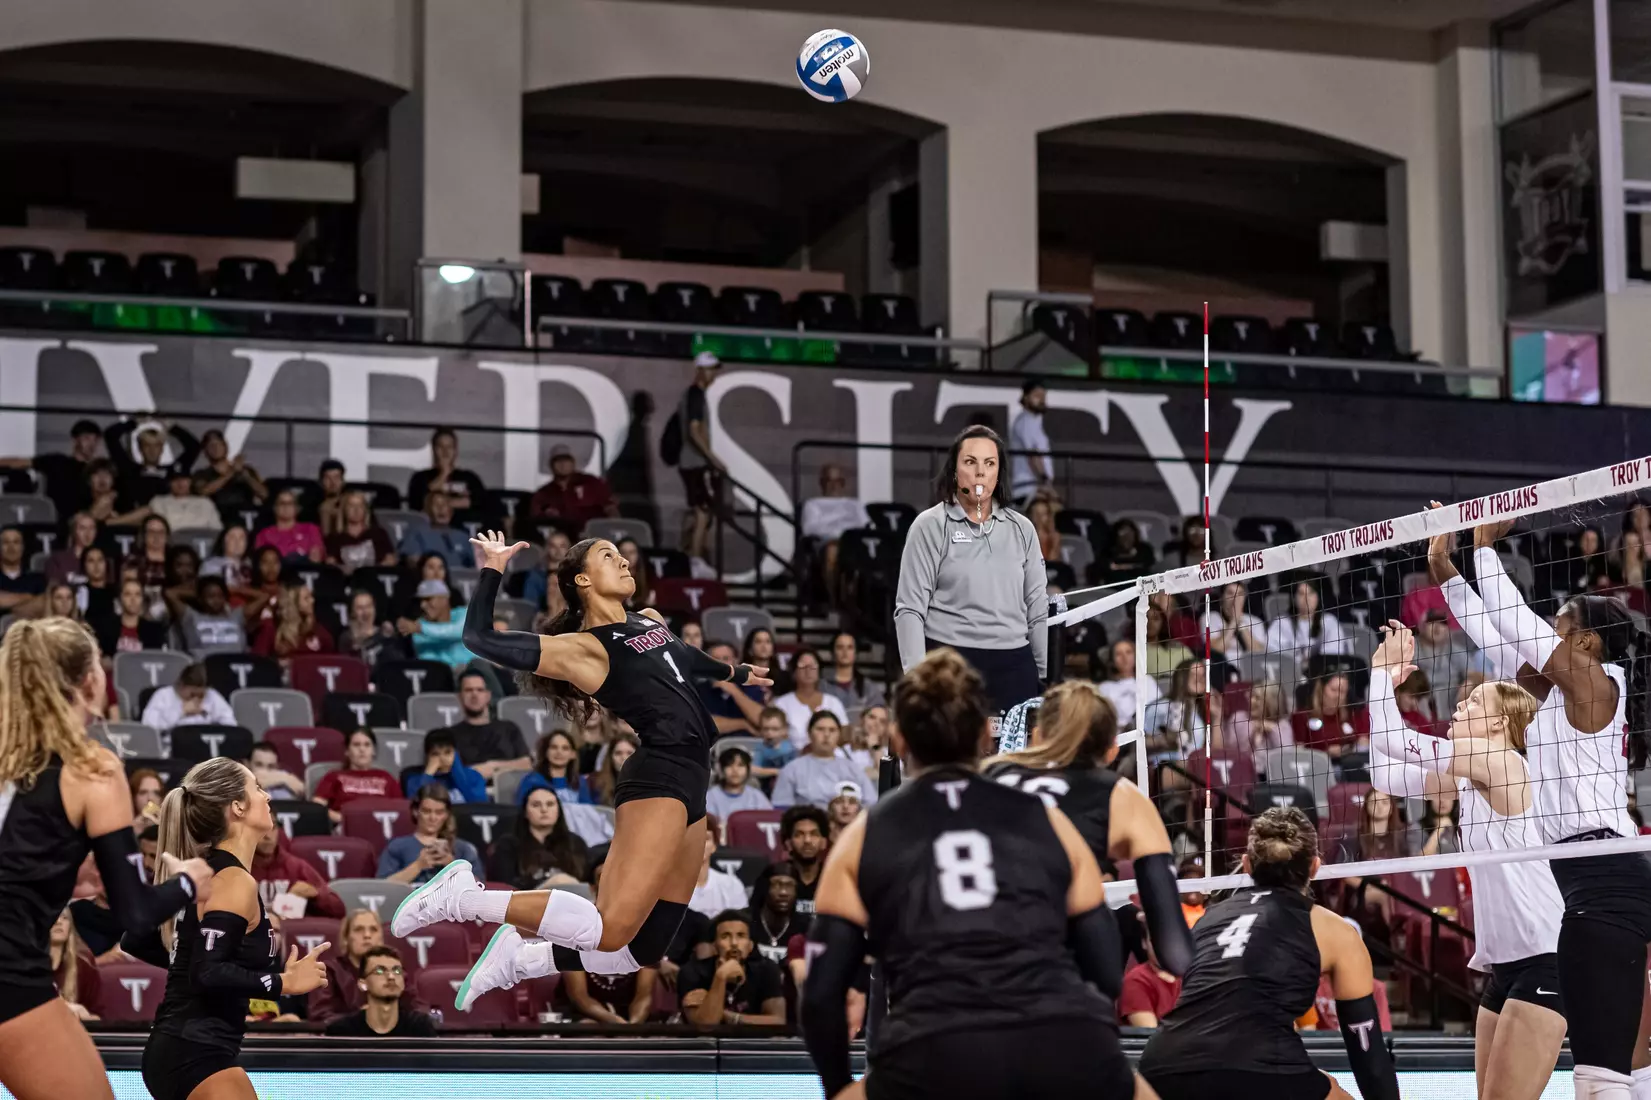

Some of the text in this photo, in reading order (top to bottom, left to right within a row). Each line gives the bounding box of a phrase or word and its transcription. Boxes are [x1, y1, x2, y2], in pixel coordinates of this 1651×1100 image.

[818, 48, 855, 78] molten
[1610, 460, 1640, 487] TROY
[1458, 485, 1538, 523] TROY TROJANS
[1322, 520, 1394, 555] TROY TROJANS
[1224, 552, 1264, 576] TROJANS
[624, 627, 674, 653] TROY
[663, 651, 685, 683] 1
[934, 780, 970, 811] T
[126, 853, 148, 884] T
[934, 829, 998, 911] 8
[201, 928, 225, 951] T
[1216, 913, 1258, 958] 4
[1348, 1019, 1375, 1052] T
